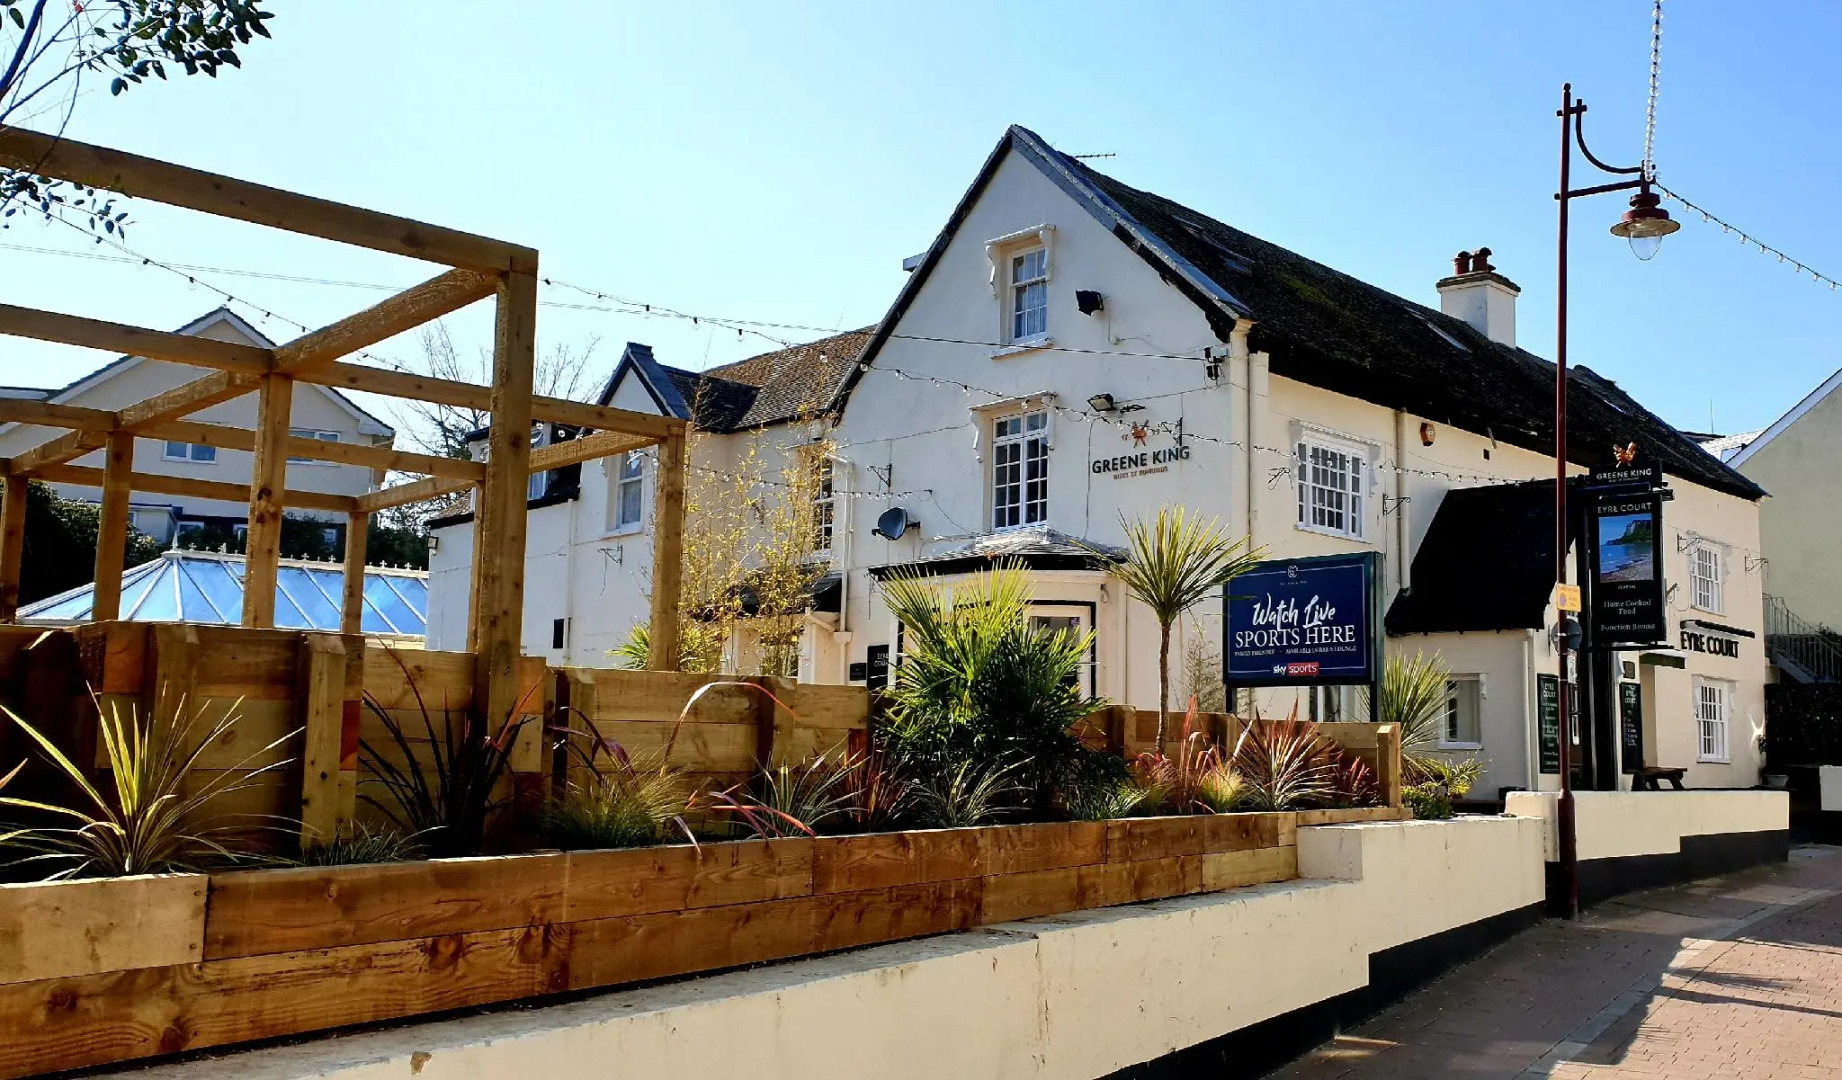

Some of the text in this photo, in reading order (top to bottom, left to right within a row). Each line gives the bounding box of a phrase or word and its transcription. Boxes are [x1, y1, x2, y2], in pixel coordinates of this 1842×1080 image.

[1092, 446, 1190, 474] GREENE KING
[1596, 470, 1629, 480] GREENE
[1630, 468, 1653, 477] KING
[1597, 502, 1653, 514] EYRE COURT
[1603, 598, 1652, 608] Home Cooked
[1252, 592, 1336, 631] Watch Live
[1618, 607, 1637, 615] Food
[1600, 622, 1656, 632] Function Rooms
[1235, 624, 1356, 648] SPORTS HERE
[1680, 631, 1740, 659] EYRE COURT
[1273, 663, 1317, 676] sky sports
